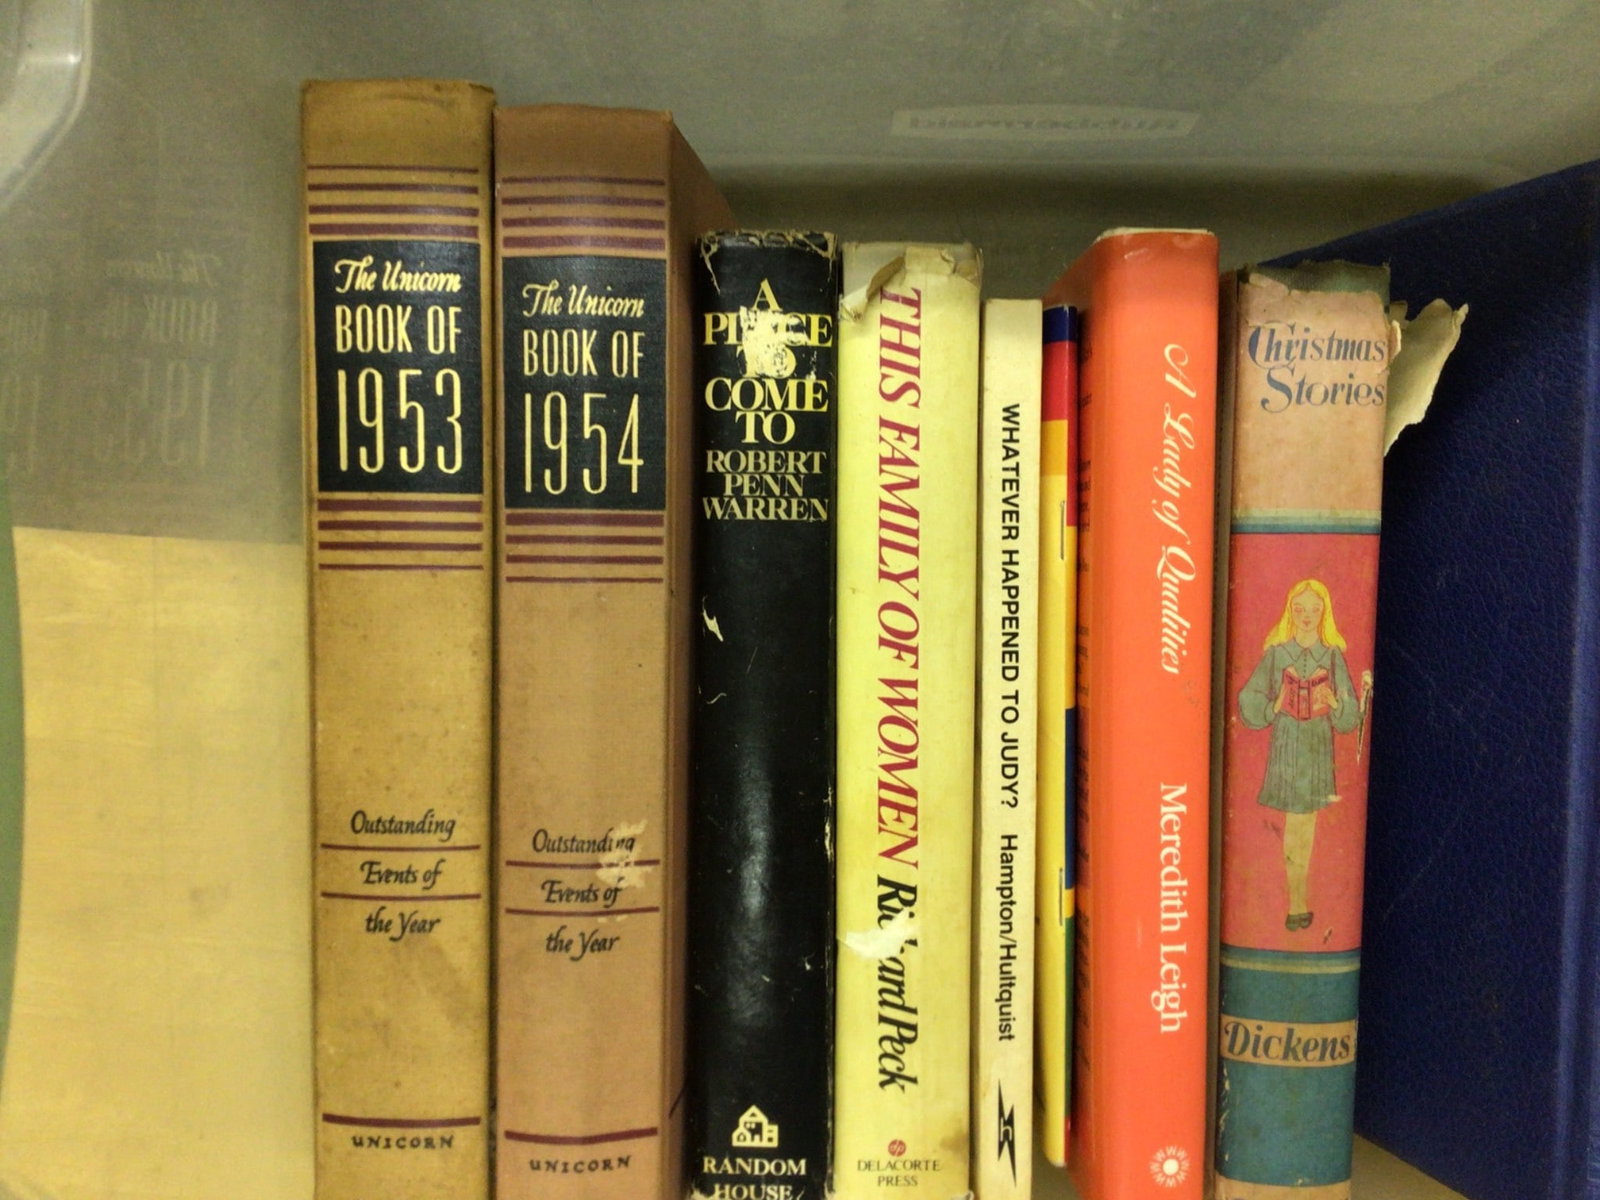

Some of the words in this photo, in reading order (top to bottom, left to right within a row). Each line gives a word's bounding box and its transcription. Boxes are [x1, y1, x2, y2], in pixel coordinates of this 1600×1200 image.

[334, 255, 376, 292] The
[381, 259, 462, 292] Unicorn
[522, 281, 563, 317] The
[568, 284, 645, 317] Unicorn
[751, 278, 783, 311] A
[335, 304, 413, 354] BOOK
[427, 305, 463, 355] OF
[703, 312, 833, 348] PLCE
[878, 286, 922, 409] THIS
[1248, 320, 1387, 368] Christmas
[523, 329, 598, 377] BOOK
[611, 330, 645, 378] OF
[1164, 343, 1197, 398] A
[704, 377, 828, 412] COME
[1261, 364, 1385, 414] Stories
[337, 367, 463, 474] 1953
[735, 411, 796, 444] TO
[524, 391, 644, 495] 1954
[706, 450, 827, 474] ROBERT
[1152, 403, 1195, 505] Lady
[723, 473, 804, 496] PENN
[1000, 404, 1020, 541] WHATEVER
[703, 497, 828, 521] WARREN
[877, 415, 921, 599] FAMILY
[1153, 500, 1189, 548] of
[1000, 549, 1019, 682] HAPPENED
[1157, 546, 1196, 675] Qualities
[877, 601, 920, 669] OF
[1000, 690, 1018, 724] TO
[876, 677, 920, 869] WOMEN
[1000, 731, 1017, 808] JUDY?
[351, 810, 456, 842] Outstanding
[532, 828, 635, 854] Outstanding
[360, 861, 418, 884] Events
[423, 859, 442, 889] of
[1160, 783, 1188, 933] Meredith
[542, 880, 598, 905] Events
[603, 877, 623, 907] of
[365, 907, 393, 934] the
[390, 911, 441, 942] Year
[546, 926, 573, 953] the
[570, 930, 620, 961] Year
[876, 874, 919, 1015] Riard
[996, 834, 1018, 1042] Hampton/Hultquist
[1151, 943, 1188, 1033] Leigh
[876, 1010, 919, 1093] Peck
[1225, 1022, 1350, 1062] Dickens
[353, 1135, 454, 1149] UNICORN
[530, 1155, 630, 1173] UNICORN
[703, 1158, 807, 1177] RANDOM
[857, 1159, 940, 1173] DELACORTE
[877, 1175, 919, 1188] PRESS
[714, 1183, 793, 1200] HOUSE
